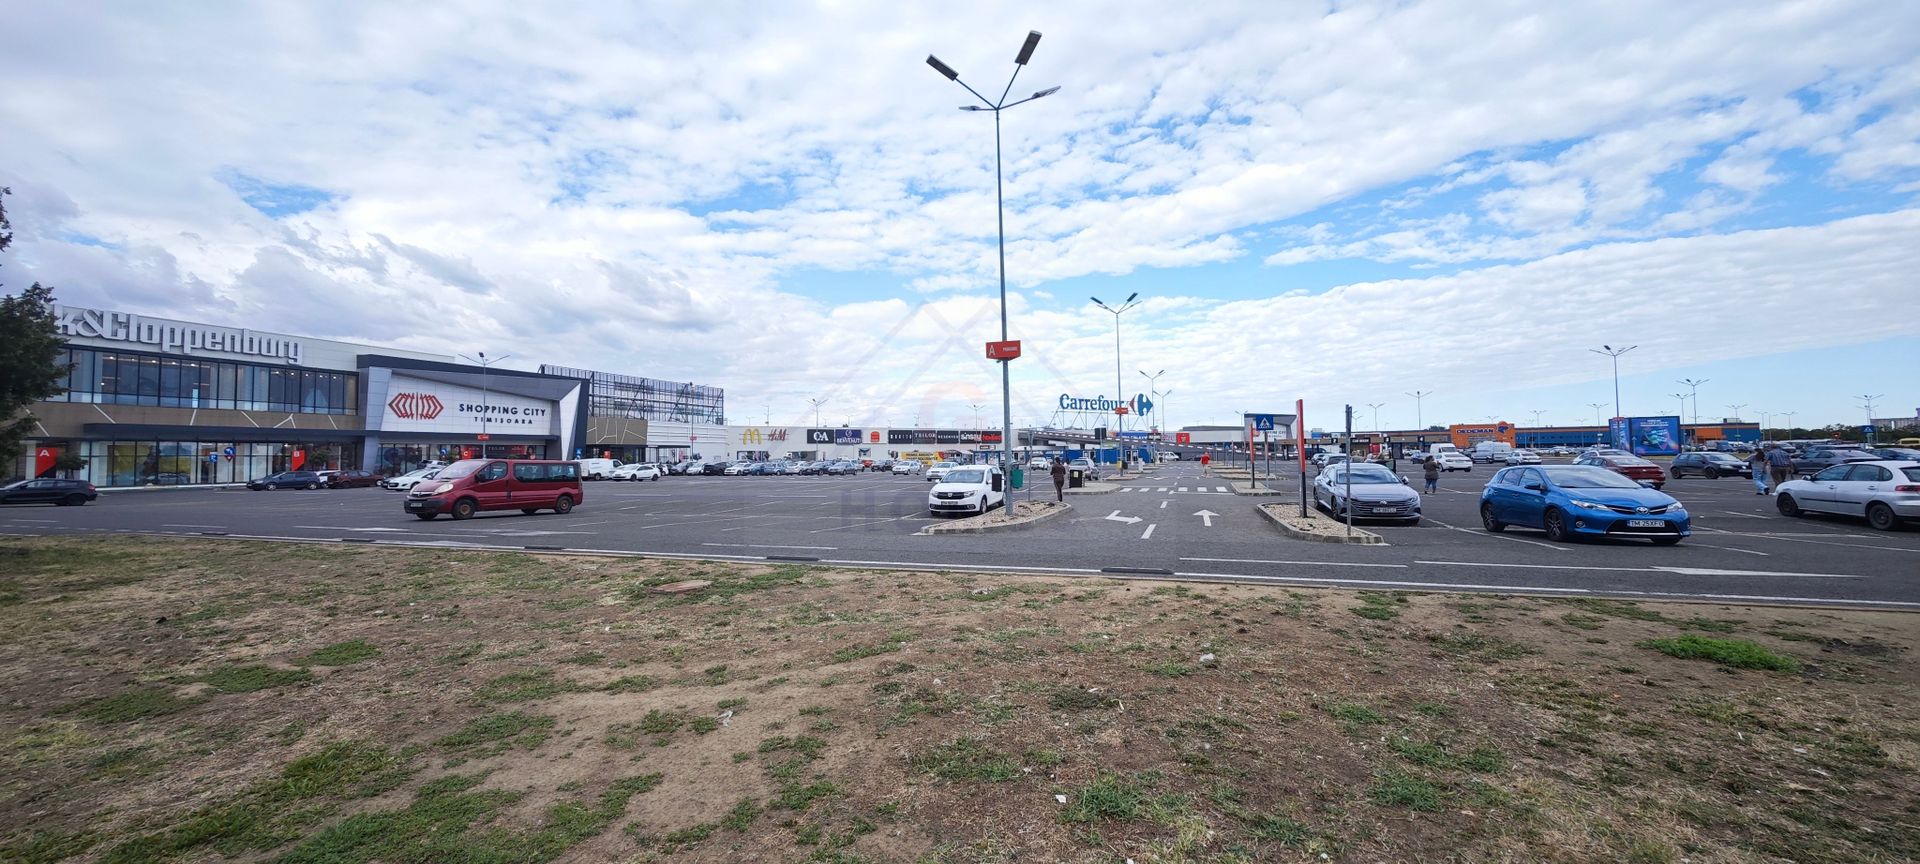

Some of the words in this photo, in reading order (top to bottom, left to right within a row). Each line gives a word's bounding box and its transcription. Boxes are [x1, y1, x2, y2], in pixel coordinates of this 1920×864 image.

[989, 344, 996, 356] A
[1060, 393, 1125, 411] Carrefour
[459, 403, 518, 417] SHOPPING
[523, 407, 547, 419] CITY
[768, 428, 787, 441] H&M
[40, 449, 50, 457] A
